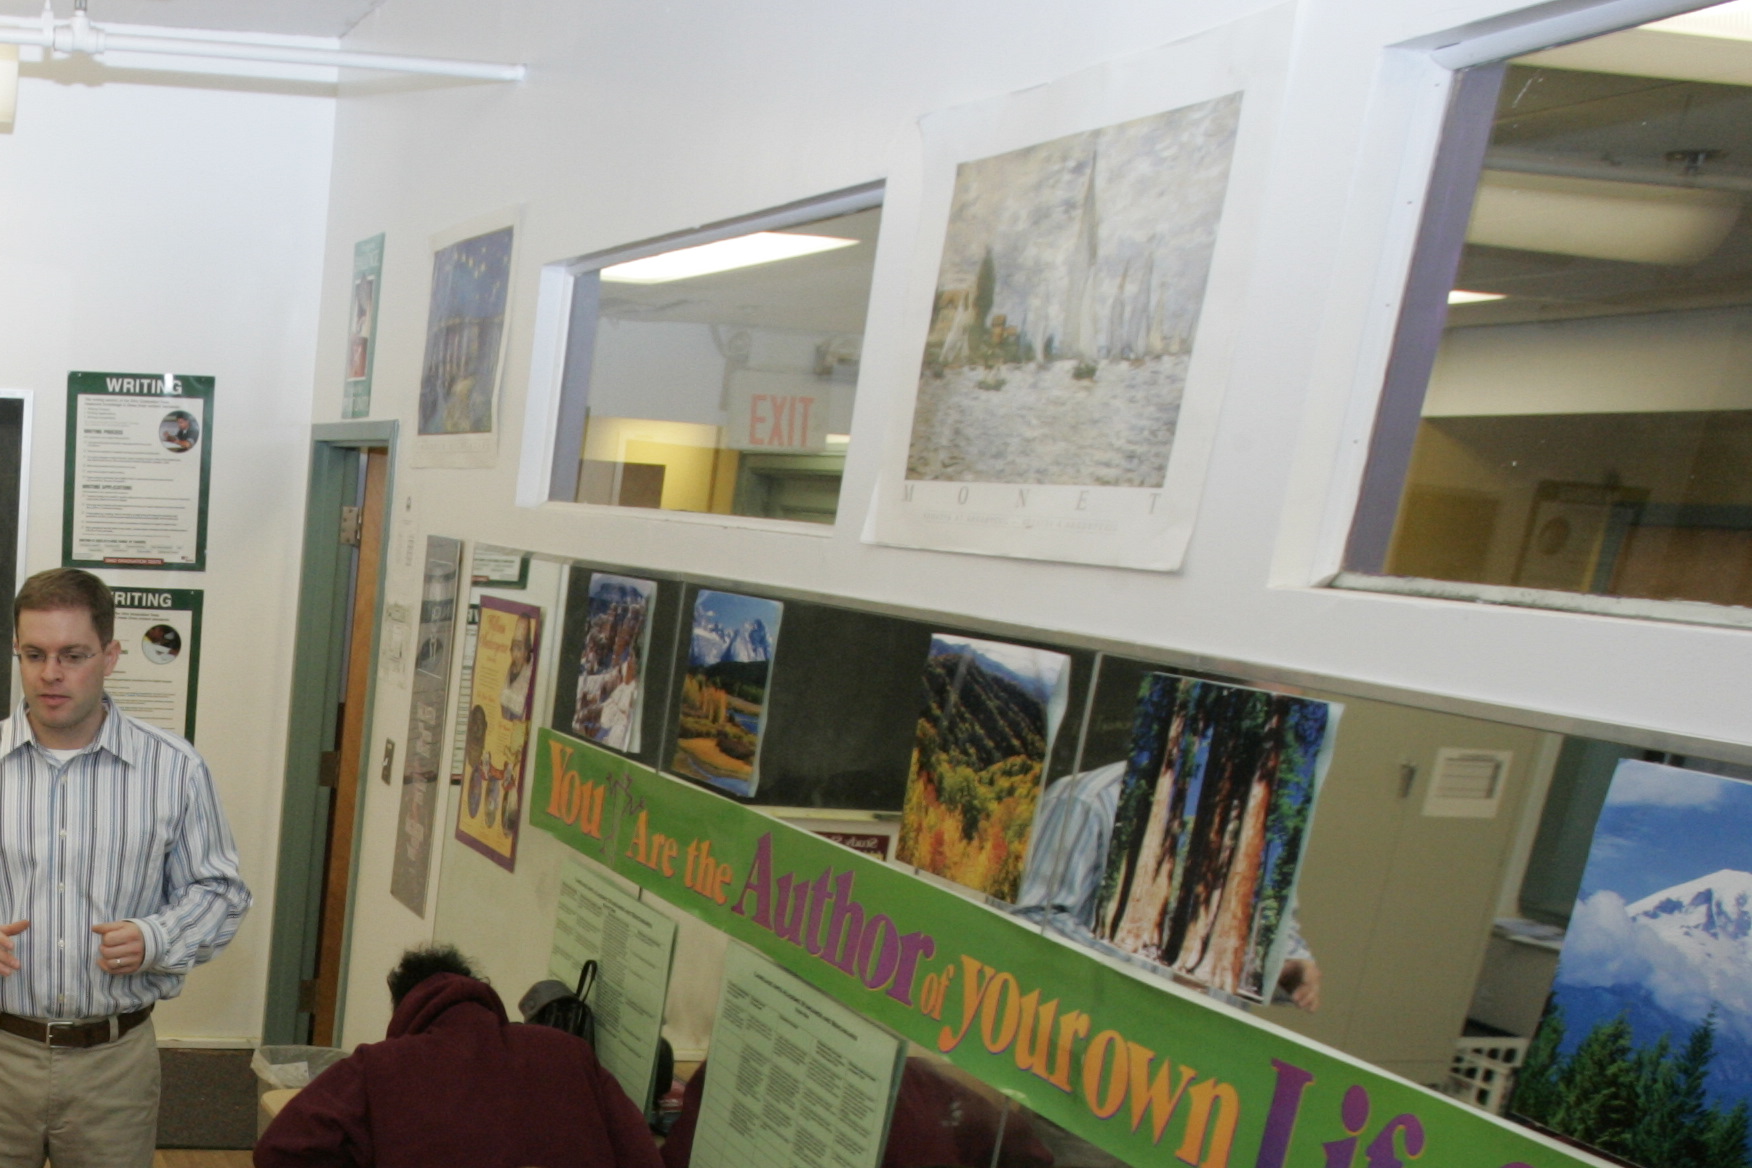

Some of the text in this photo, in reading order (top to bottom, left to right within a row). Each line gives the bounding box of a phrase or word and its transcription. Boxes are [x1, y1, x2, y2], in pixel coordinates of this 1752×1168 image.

[749, 393, 816, 448] EXIT
[901, 484, 1162, 515] MONET
[112, 592, 172, 608] RITING
[546, 739, 607, 841] You
[624, 811, 679, 878] Are
[684, 838, 735, 906] the
[731, 832, 936, 1007] Author
[920, 951, 956, 1021] of
